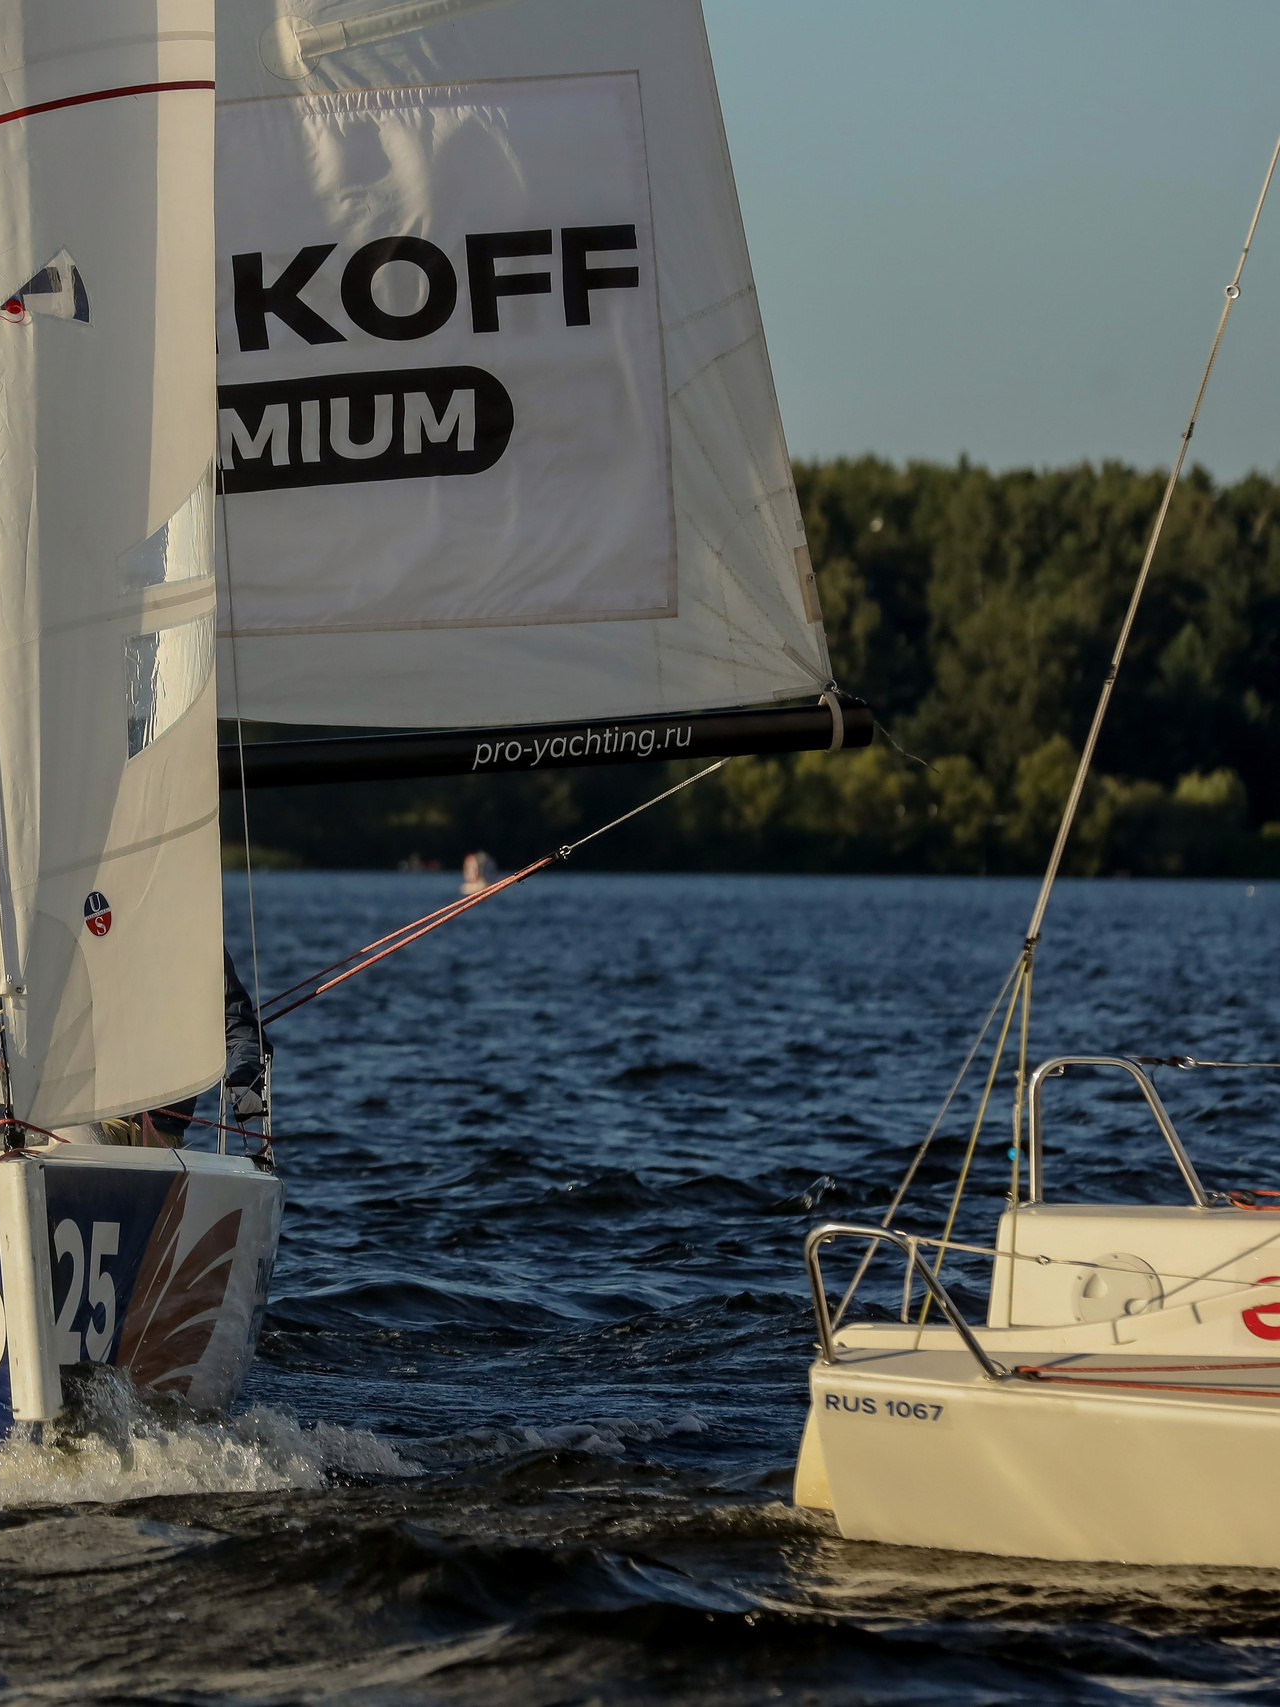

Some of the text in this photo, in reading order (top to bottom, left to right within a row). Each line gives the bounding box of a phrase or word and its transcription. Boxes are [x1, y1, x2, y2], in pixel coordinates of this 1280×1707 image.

[216, 224, 640, 354] KOFF
[472, 726, 692, 770] pro-yachting.ru
[53, 1218, 121, 1366] 25
[824, 1393, 944, 1421] RUS 1067
